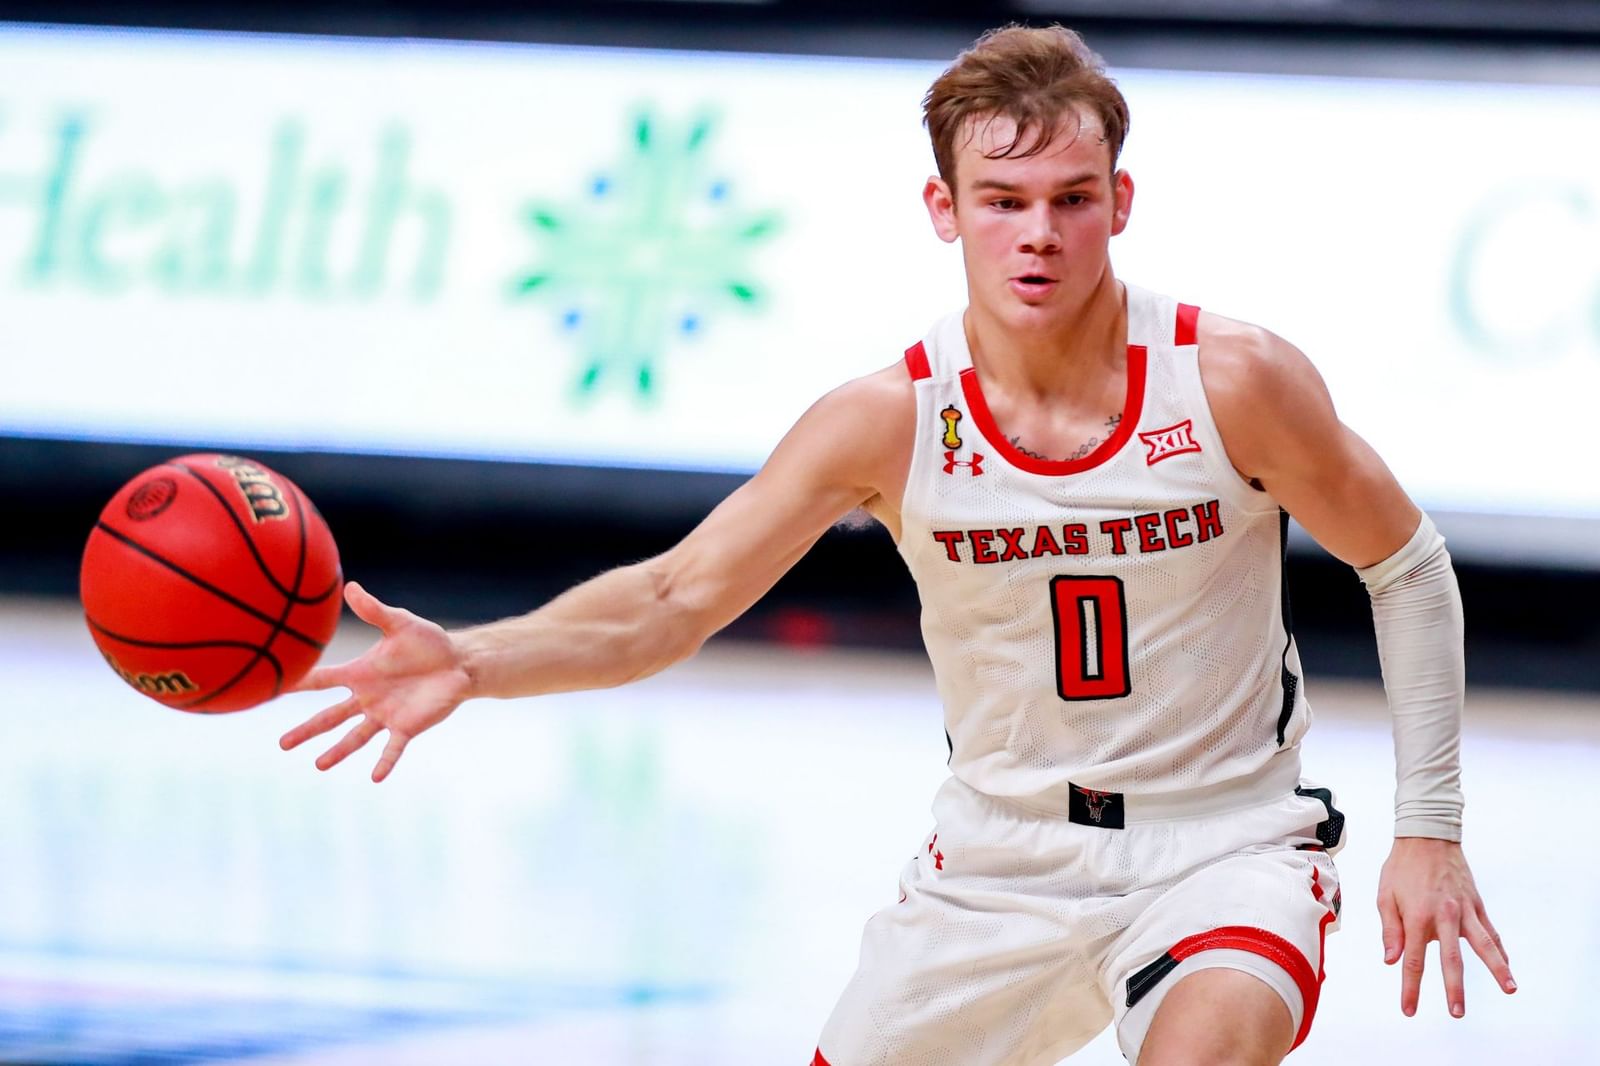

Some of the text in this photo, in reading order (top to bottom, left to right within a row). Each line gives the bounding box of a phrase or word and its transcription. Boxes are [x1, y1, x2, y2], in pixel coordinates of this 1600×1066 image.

[1139, 421, 1200, 465] XII
[933, 499, 1224, 564] TEXAS TECH
[1049, 574, 1132, 701] 0
